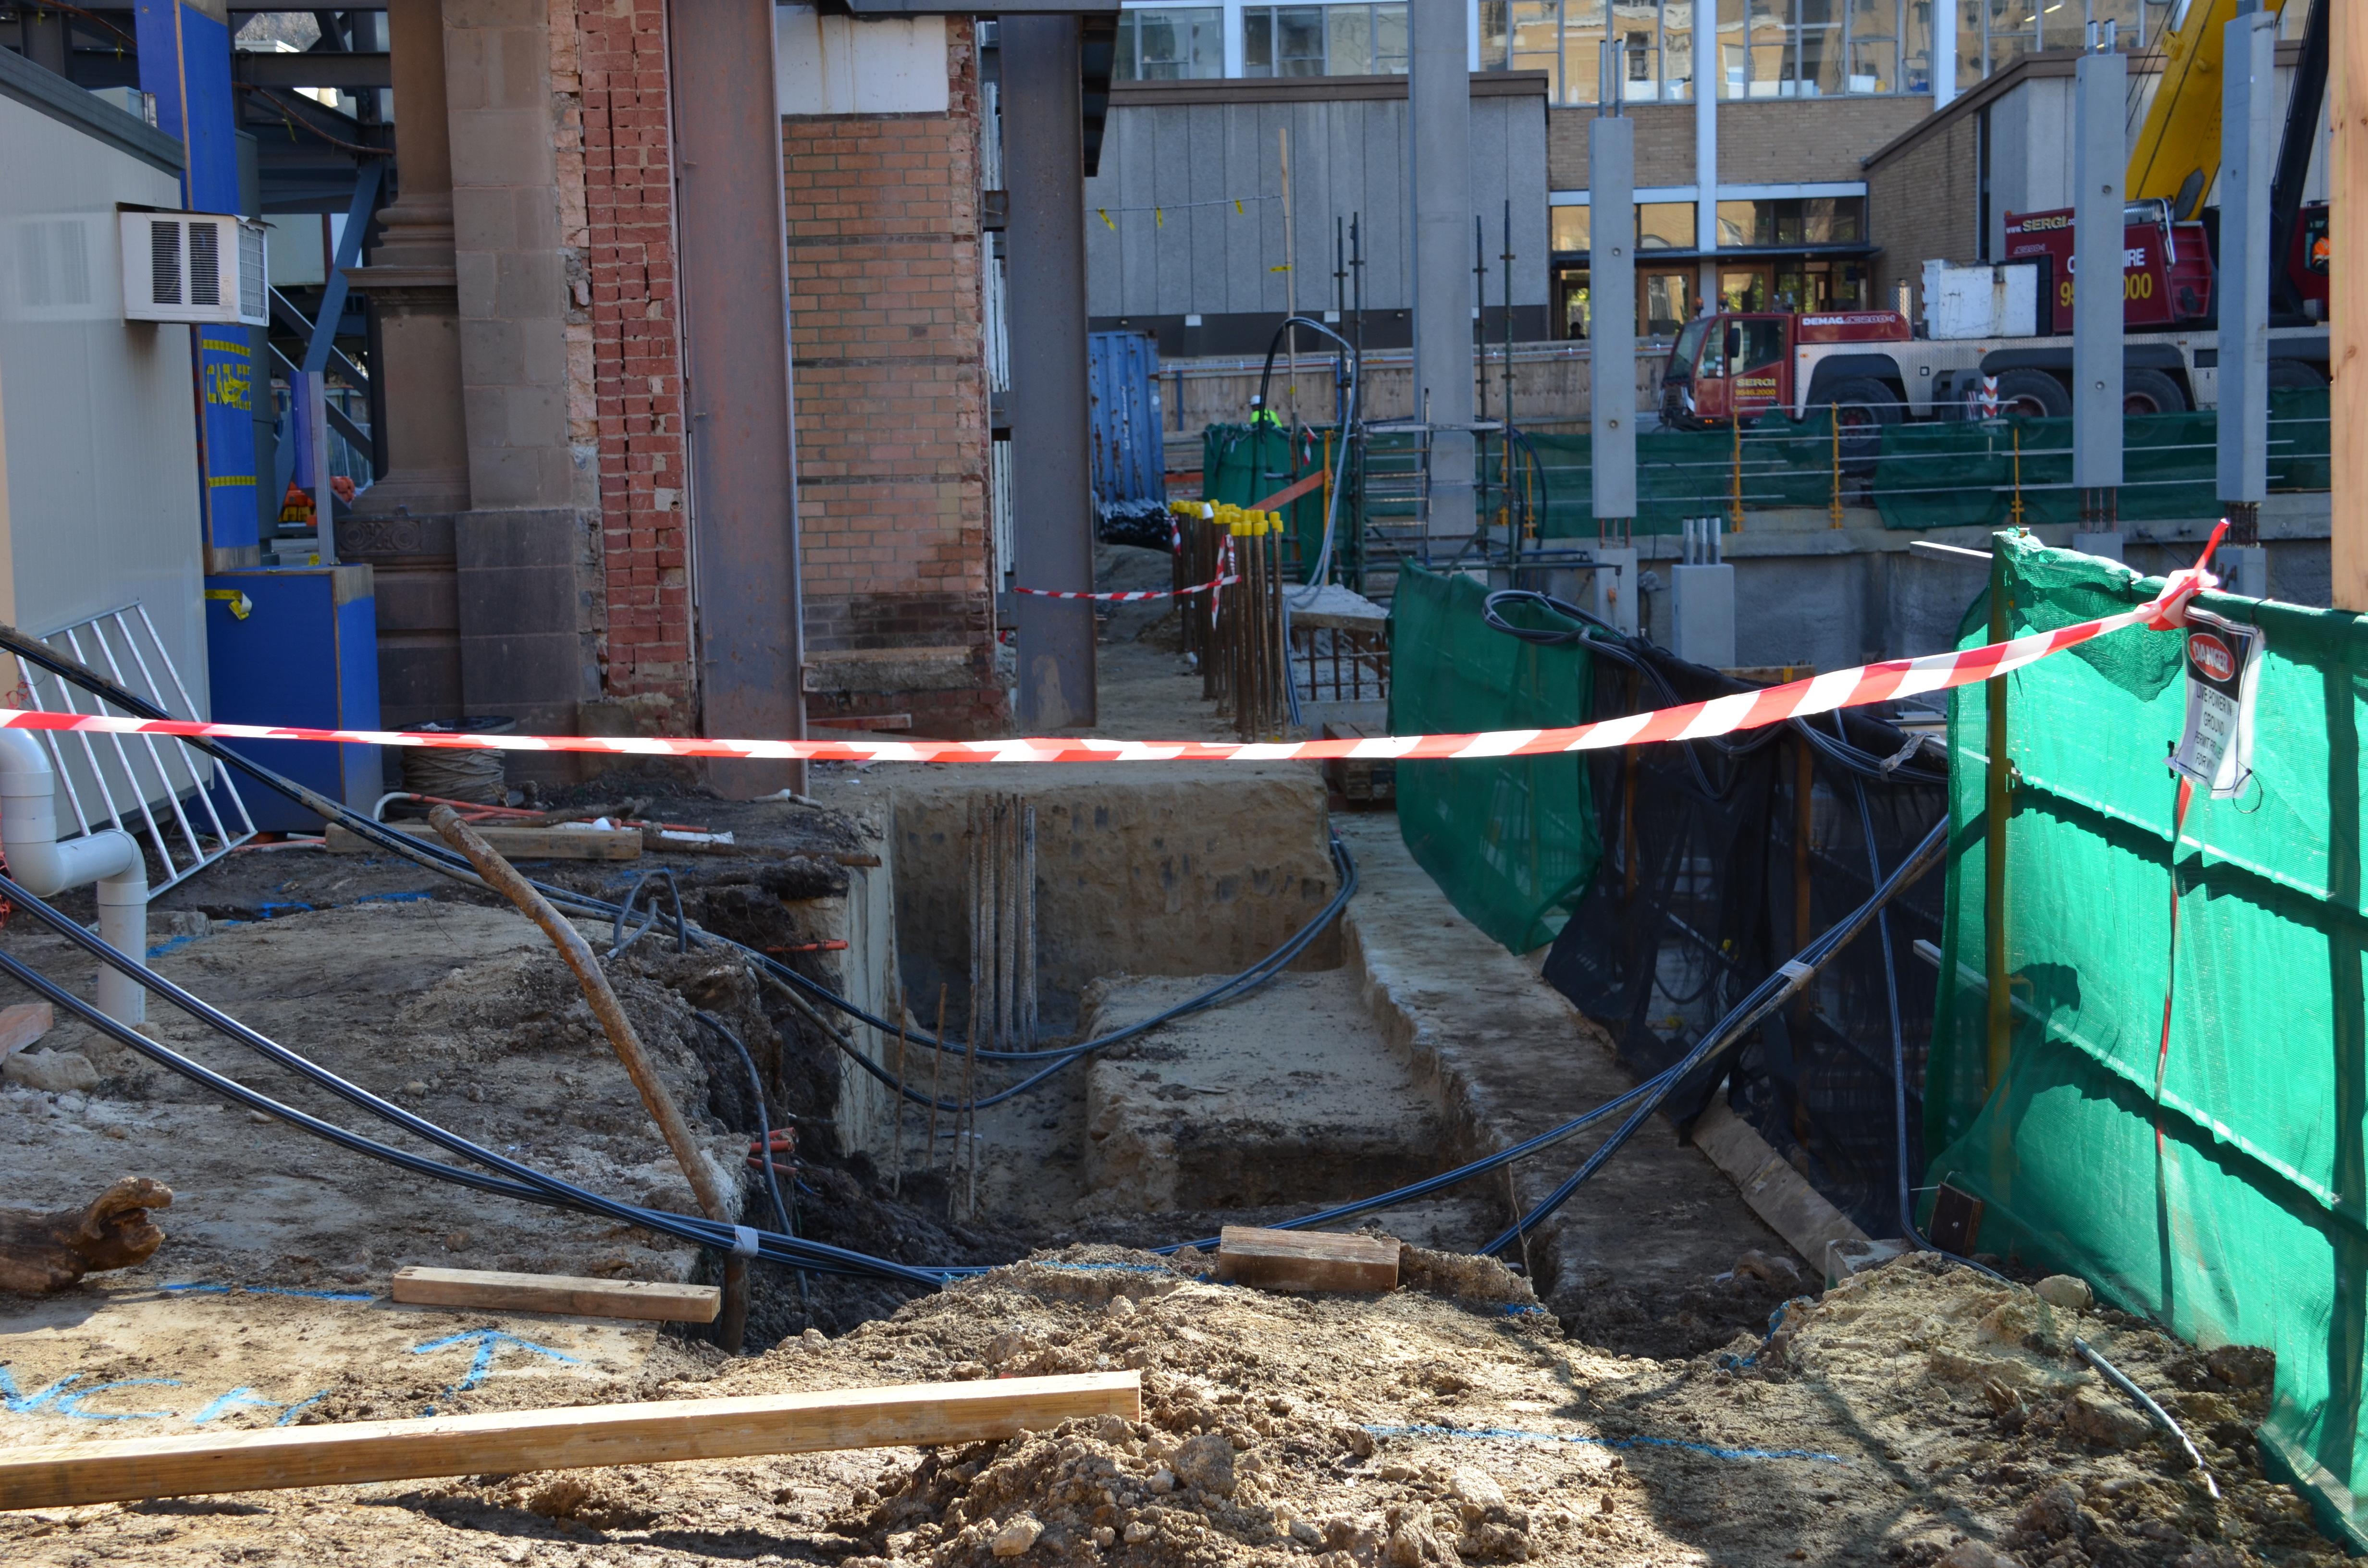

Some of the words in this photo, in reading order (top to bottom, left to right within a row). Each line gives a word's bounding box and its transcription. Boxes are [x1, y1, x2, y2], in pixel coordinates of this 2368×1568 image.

[2123, 248, 2145, 267] IRE
[1802, 317, 1844, 326] DEMAG
[1736, 378, 1776, 387] SERGI
[2192, 641, 2230, 674] DANGER
[2196, 683, 2208, 703] LIVE
[2208, 689, 2226, 714] POWER
[2226, 699, 2232, 717] IN
[2203, 711, 2224, 736] GROUND
[2194, 730, 2210, 749] PERMIT
[2195, 752, 2207, 767] FOR
